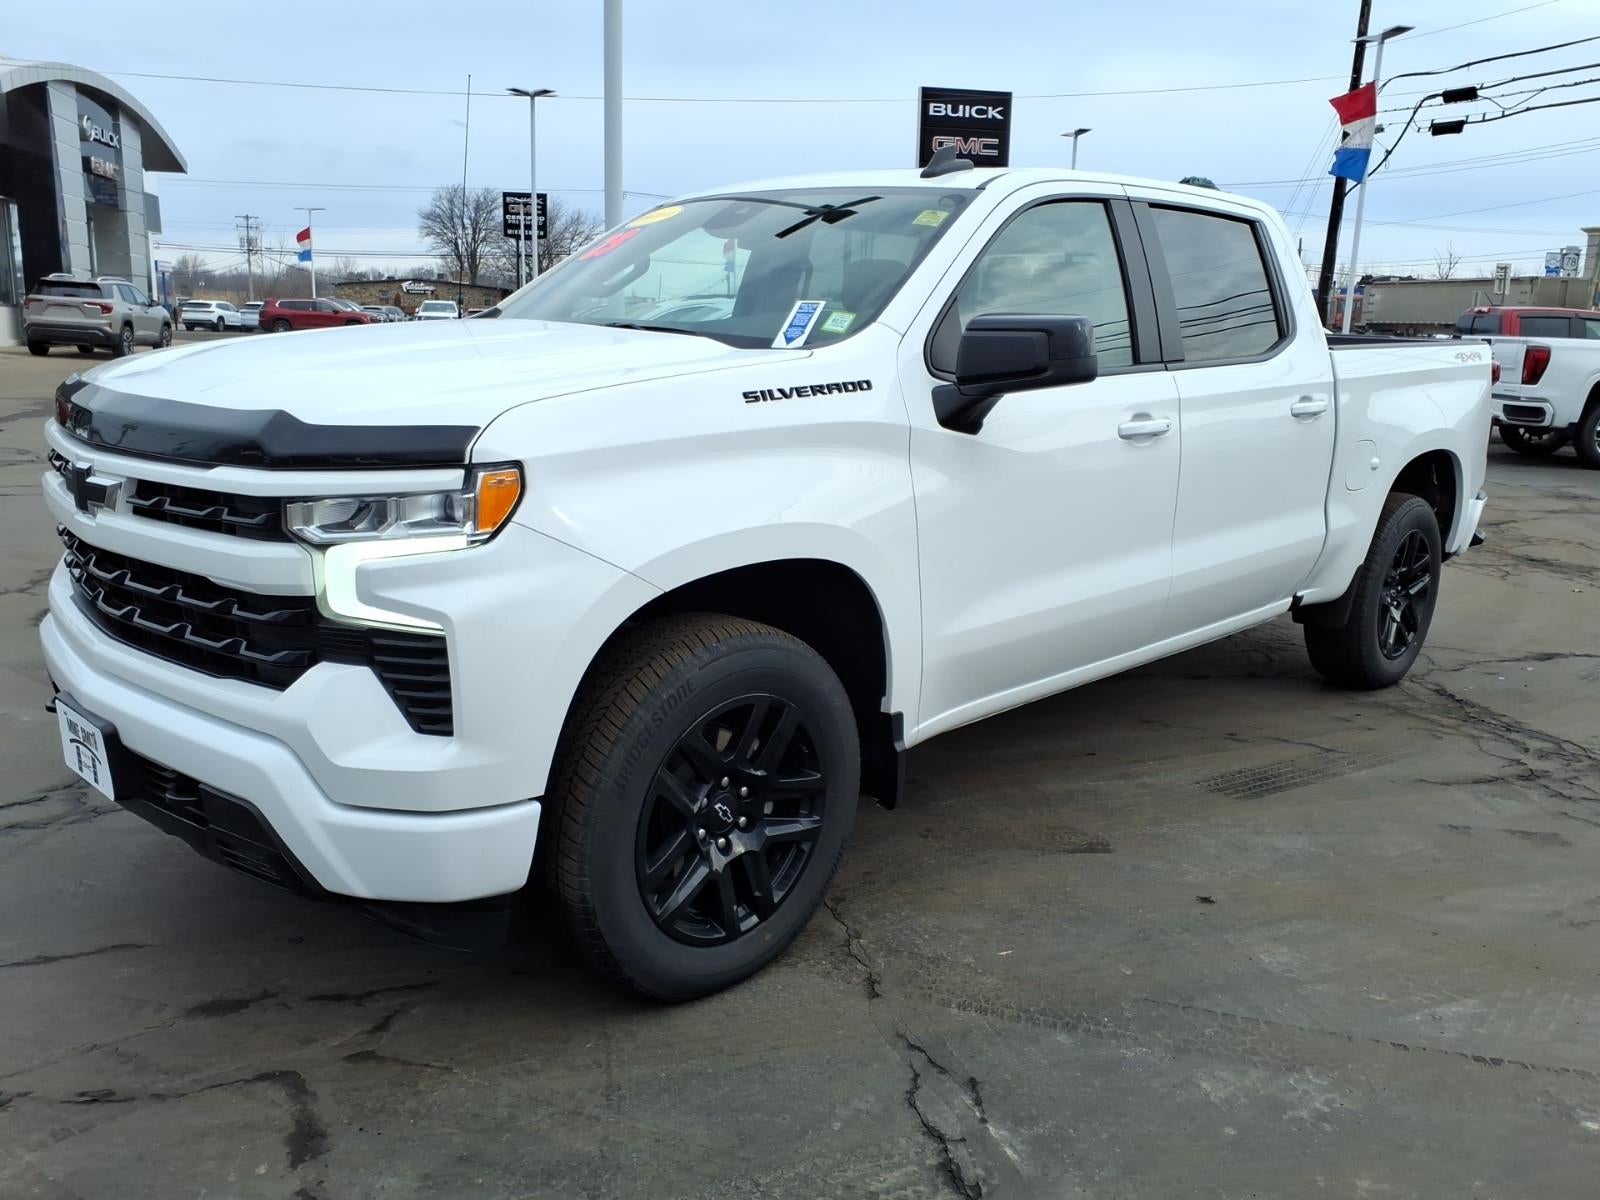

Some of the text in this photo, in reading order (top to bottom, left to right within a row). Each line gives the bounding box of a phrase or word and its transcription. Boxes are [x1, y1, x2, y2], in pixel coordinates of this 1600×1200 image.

[929, 103, 1004, 119] BUICK
[90, 125, 120, 148] BUICK
[932, 136, 999, 156] GMC
[91, 156, 120, 181] GMC
[1566, 256, 1578, 267] 78
[742, 379, 873, 404] SILVERADO
[66, 716, 98, 752] MIKE SMITH
[612, 678, 697, 797] BRIDGESTONE
